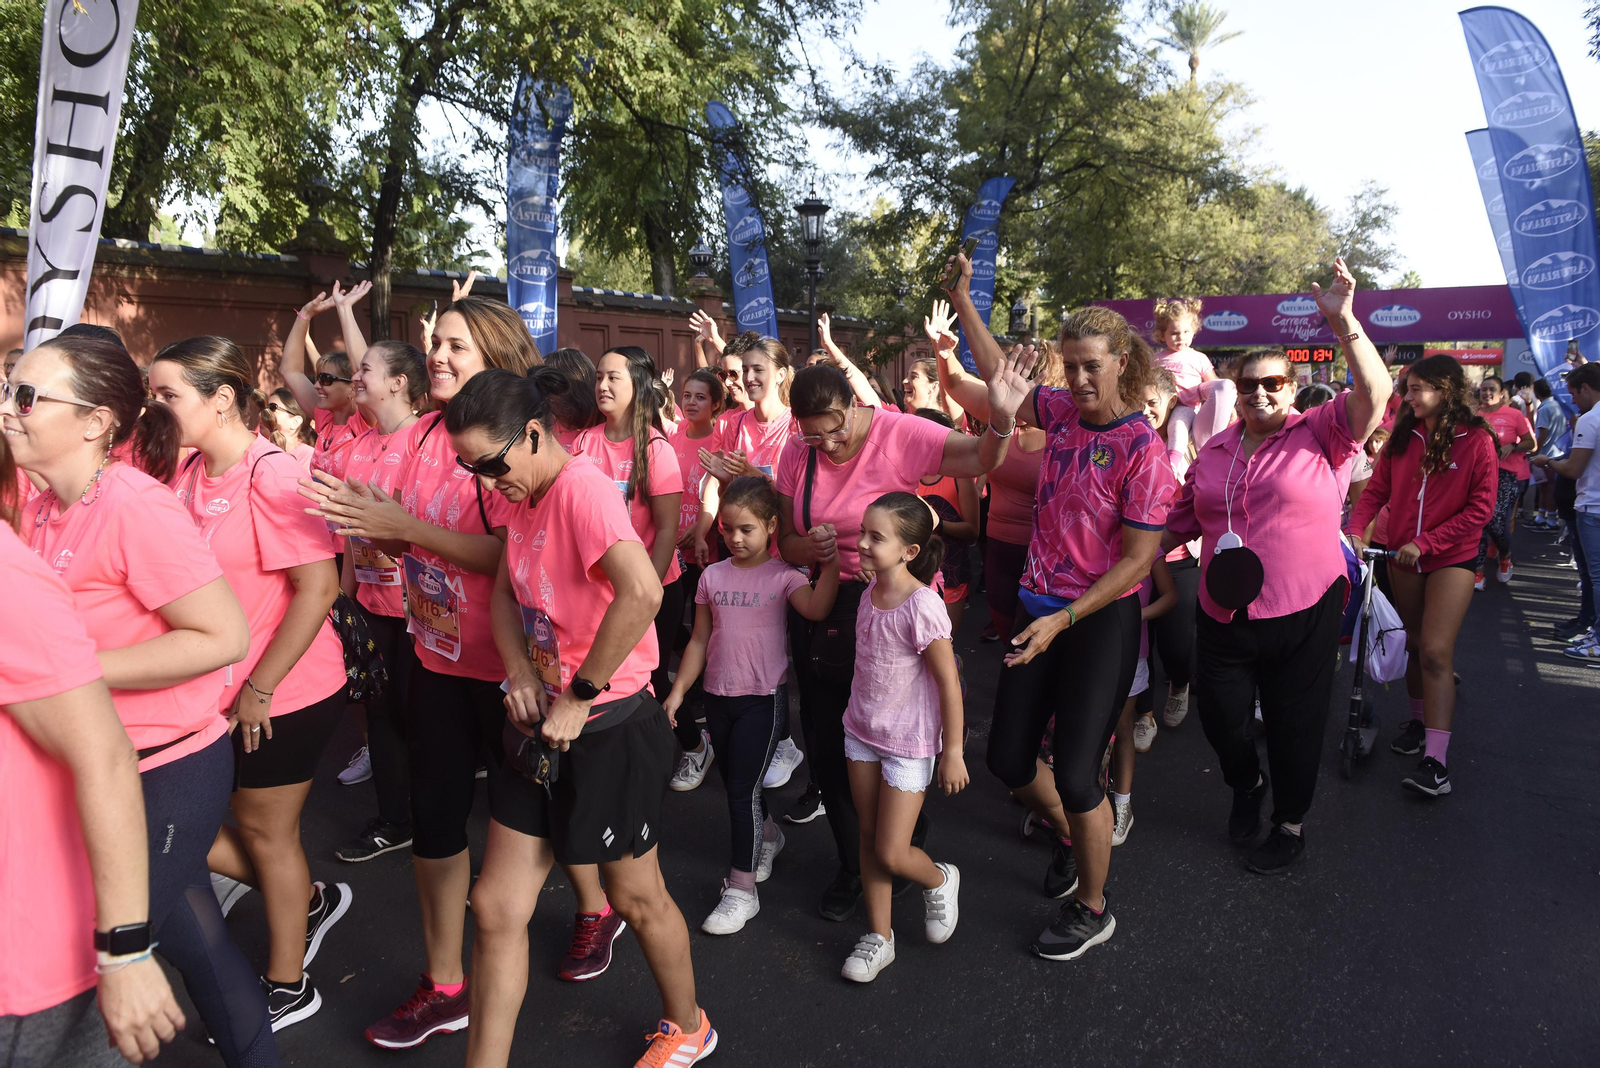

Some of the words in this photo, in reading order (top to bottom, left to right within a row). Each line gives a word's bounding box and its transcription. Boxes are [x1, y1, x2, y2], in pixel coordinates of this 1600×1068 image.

[27, 0, 119, 338] YSHO
[1271, 314, 1310, 327] Carrera
[1373, 313, 1418, 322] ASTURIANA
[1447, 309, 1492, 321] OYSHO
[1205, 318, 1246, 328] ASTURIANA
[1280, 326, 1288, 334] de
[1292, 324, 1324, 342] Mujer
[162, 823, 175, 854] DOMYOS
